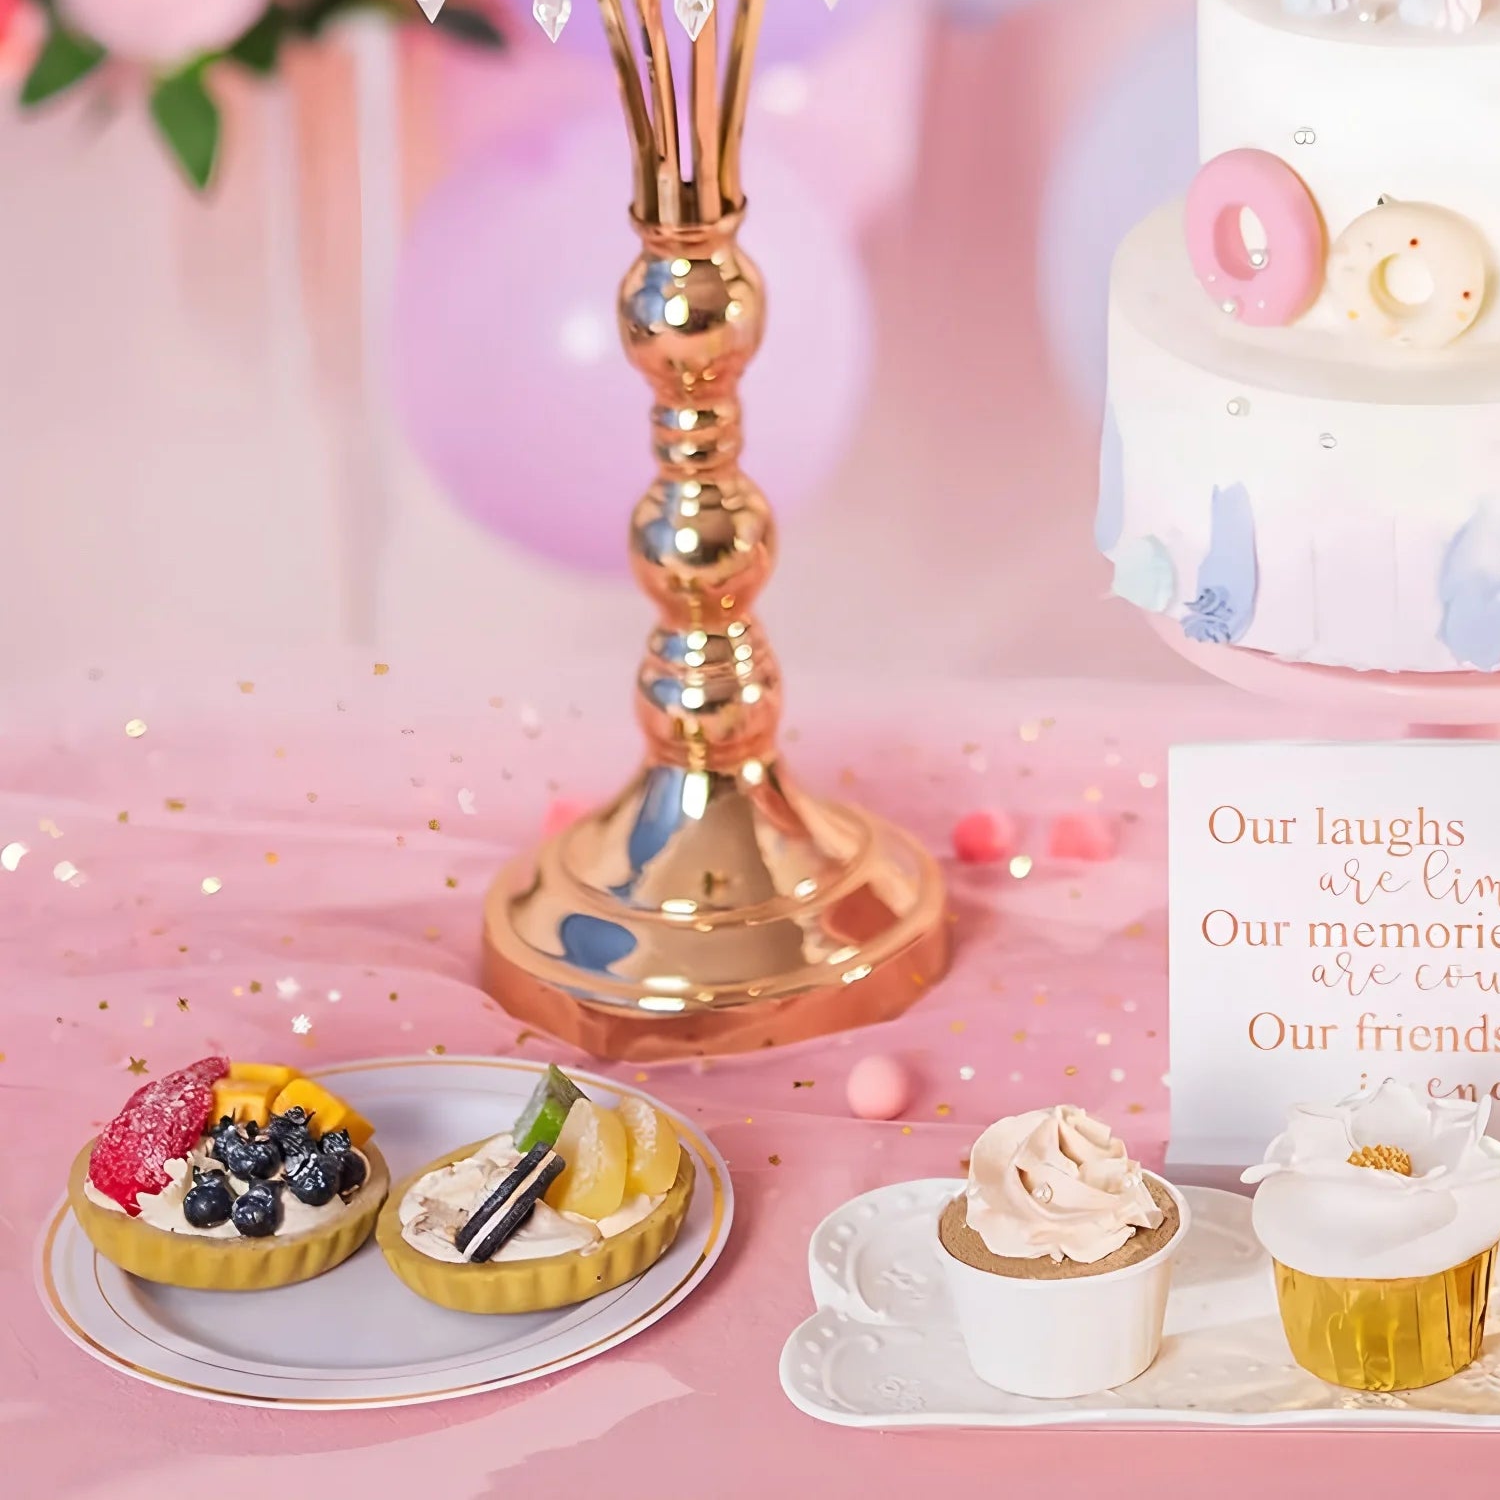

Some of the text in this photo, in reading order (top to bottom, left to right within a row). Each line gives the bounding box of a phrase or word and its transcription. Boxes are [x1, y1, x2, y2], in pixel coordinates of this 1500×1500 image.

[1208, 805, 1465, 857] Our laughs
[1319, 858, 1411, 905] are
[1201, 909, 1291, 947] Our
[1311, 951, 1401, 996] are
[1248, 1011, 1339, 1051] Our
